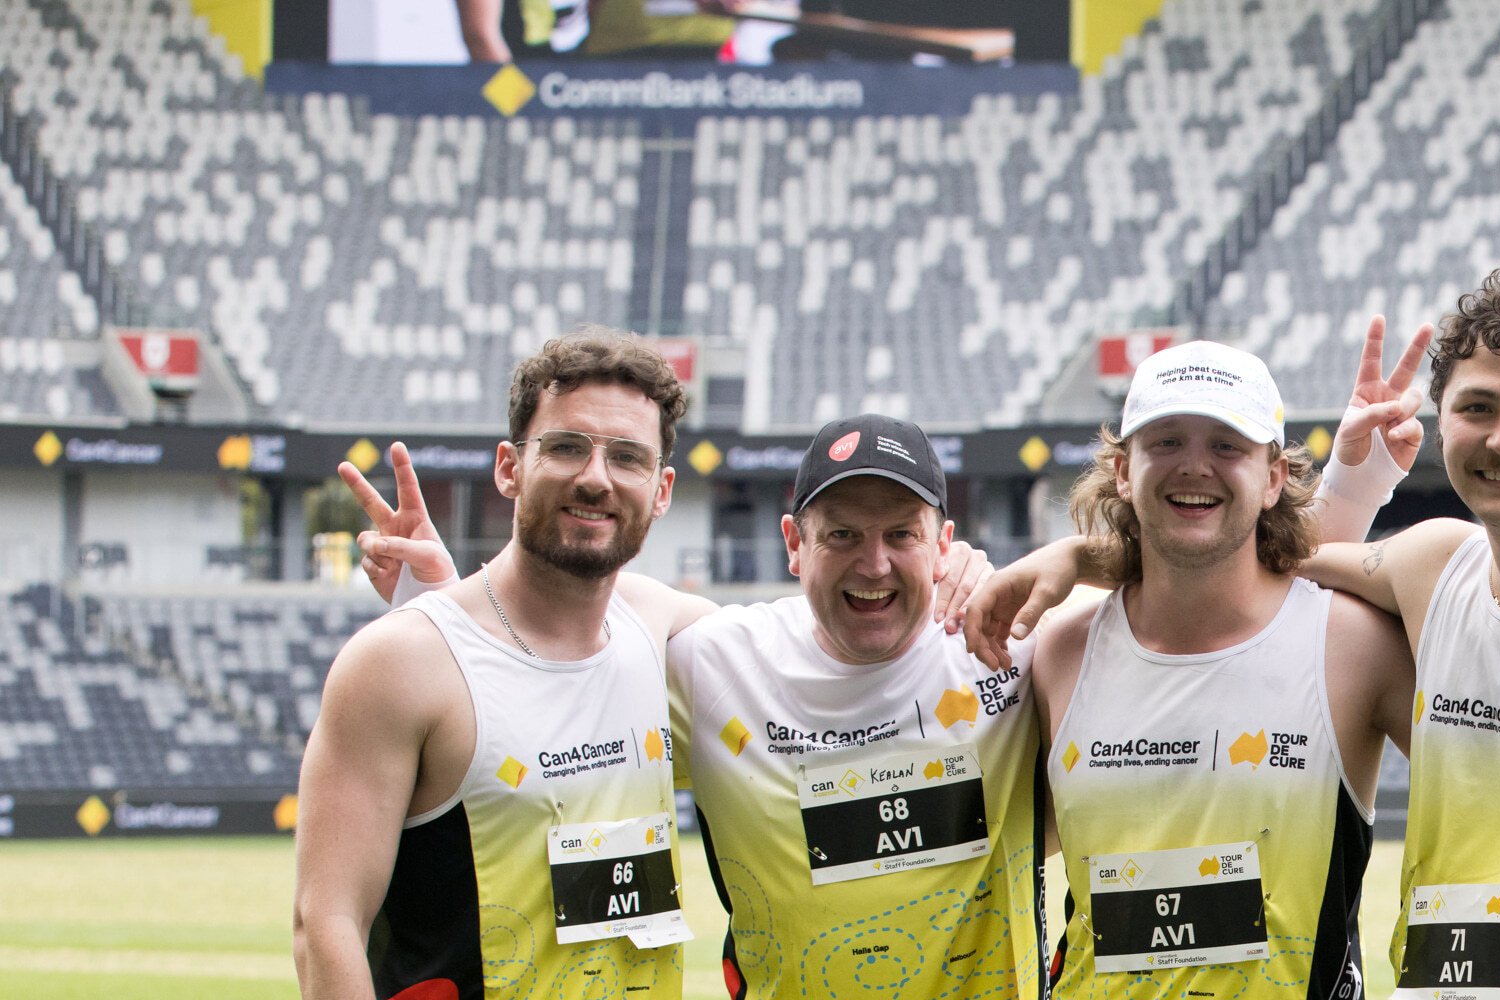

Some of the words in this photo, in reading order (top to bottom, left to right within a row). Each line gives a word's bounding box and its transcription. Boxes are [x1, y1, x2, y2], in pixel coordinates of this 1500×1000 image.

[539, 71, 725, 107] CommBank
[728, 72, 863, 107] Stadium
[1156, 366, 1187, 380] Helping
[1189, 365, 1210, 373] beat
[1212, 368, 1243, 383] cancer,
[1162, 377, 1177, 386] one
[1214, 377, 1234, 387] time
[975, 666, 1020, 692] TOUR
[980, 688, 1004, 706] DE
[1429, 713, 1459, 727] Changing
[1459, 718, 1477, 729] lives,
[767, 738, 804, 755] Changing
[867, 728, 900, 743] cancer
[1271, 732, 1308, 747] TOUR
[538, 739, 625, 768] Can4Cancer
[1090, 738, 1200, 757] Can4Cancer
[1270, 745, 1289, 756] DE
[944, 755, 964, 764] TOUR
[945, 763, 956, 771] DE
[1089, 758, 1122, 768] Changing
[1123, 757, 1143, 767] lives,
[1144, 757, 1171, 767] ending
[1171, 756, 1199, 765] cancer
[1269, 756, 1305, 770] CURE
[542, 764, 576, 779] Changing
[576, 763, 592, 773] lives,
[607, 756, 627, 766] cancer
[870, 762, 914, 784] KEALAN
[946, 768, 967, 777] CURE
[811, 780, 834, 793] can
[879, 798, 909, 823] 68
[561, 838, 582, 849] can
[876, 825, 923, 854] AV1
[884, 862, 901, 870] Staff
[902, 856, 936, 868] Foundation
[1221, 854, 1243, 863] TOUR
[613, 861, 634, 885] 66
[1099, 868, 1117, 878] can
[1222, 867, 1244, 876] CURE
[607, 890, 640, 917] AV1
[1155, 893, 1181, 916] 67
[1415, 901, 1428, 910] can
[625, 923, 648, 933] Foundation
[1150, 923, 1196, 947] AV1
[1451, 928, 1466, 952] 71
[852, 946, 871, 956] Halls
[873, 944, 889, 954] Gap
[1157, 958, 1174, 966] Staff
[1174, 956, 1207, 964] Foundation
[1439, 960, 1473, 983] AV1
